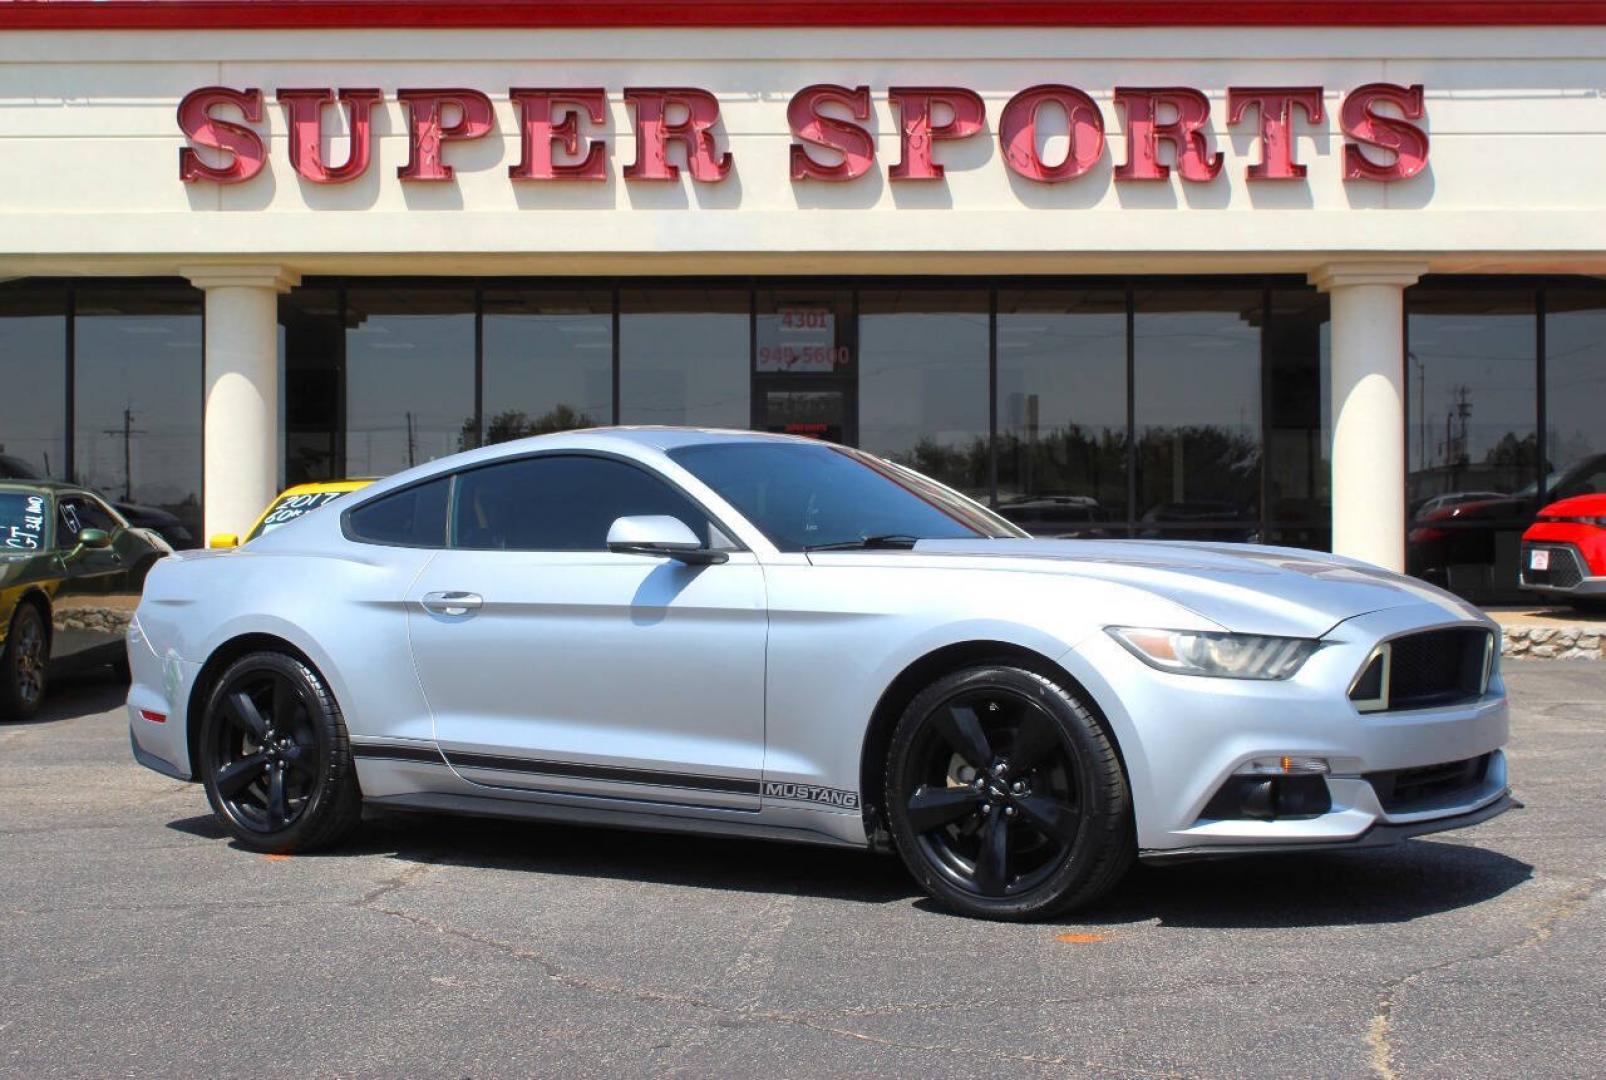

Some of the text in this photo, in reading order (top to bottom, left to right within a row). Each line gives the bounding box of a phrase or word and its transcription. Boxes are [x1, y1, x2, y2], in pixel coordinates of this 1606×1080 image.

[177, 83, 1429, 184] SUPER SPORTS
[782, 309, 828, 328] 4301
[276, 492, 340, 509] 2017
[765, 782, 857, 807] MUSTANG
